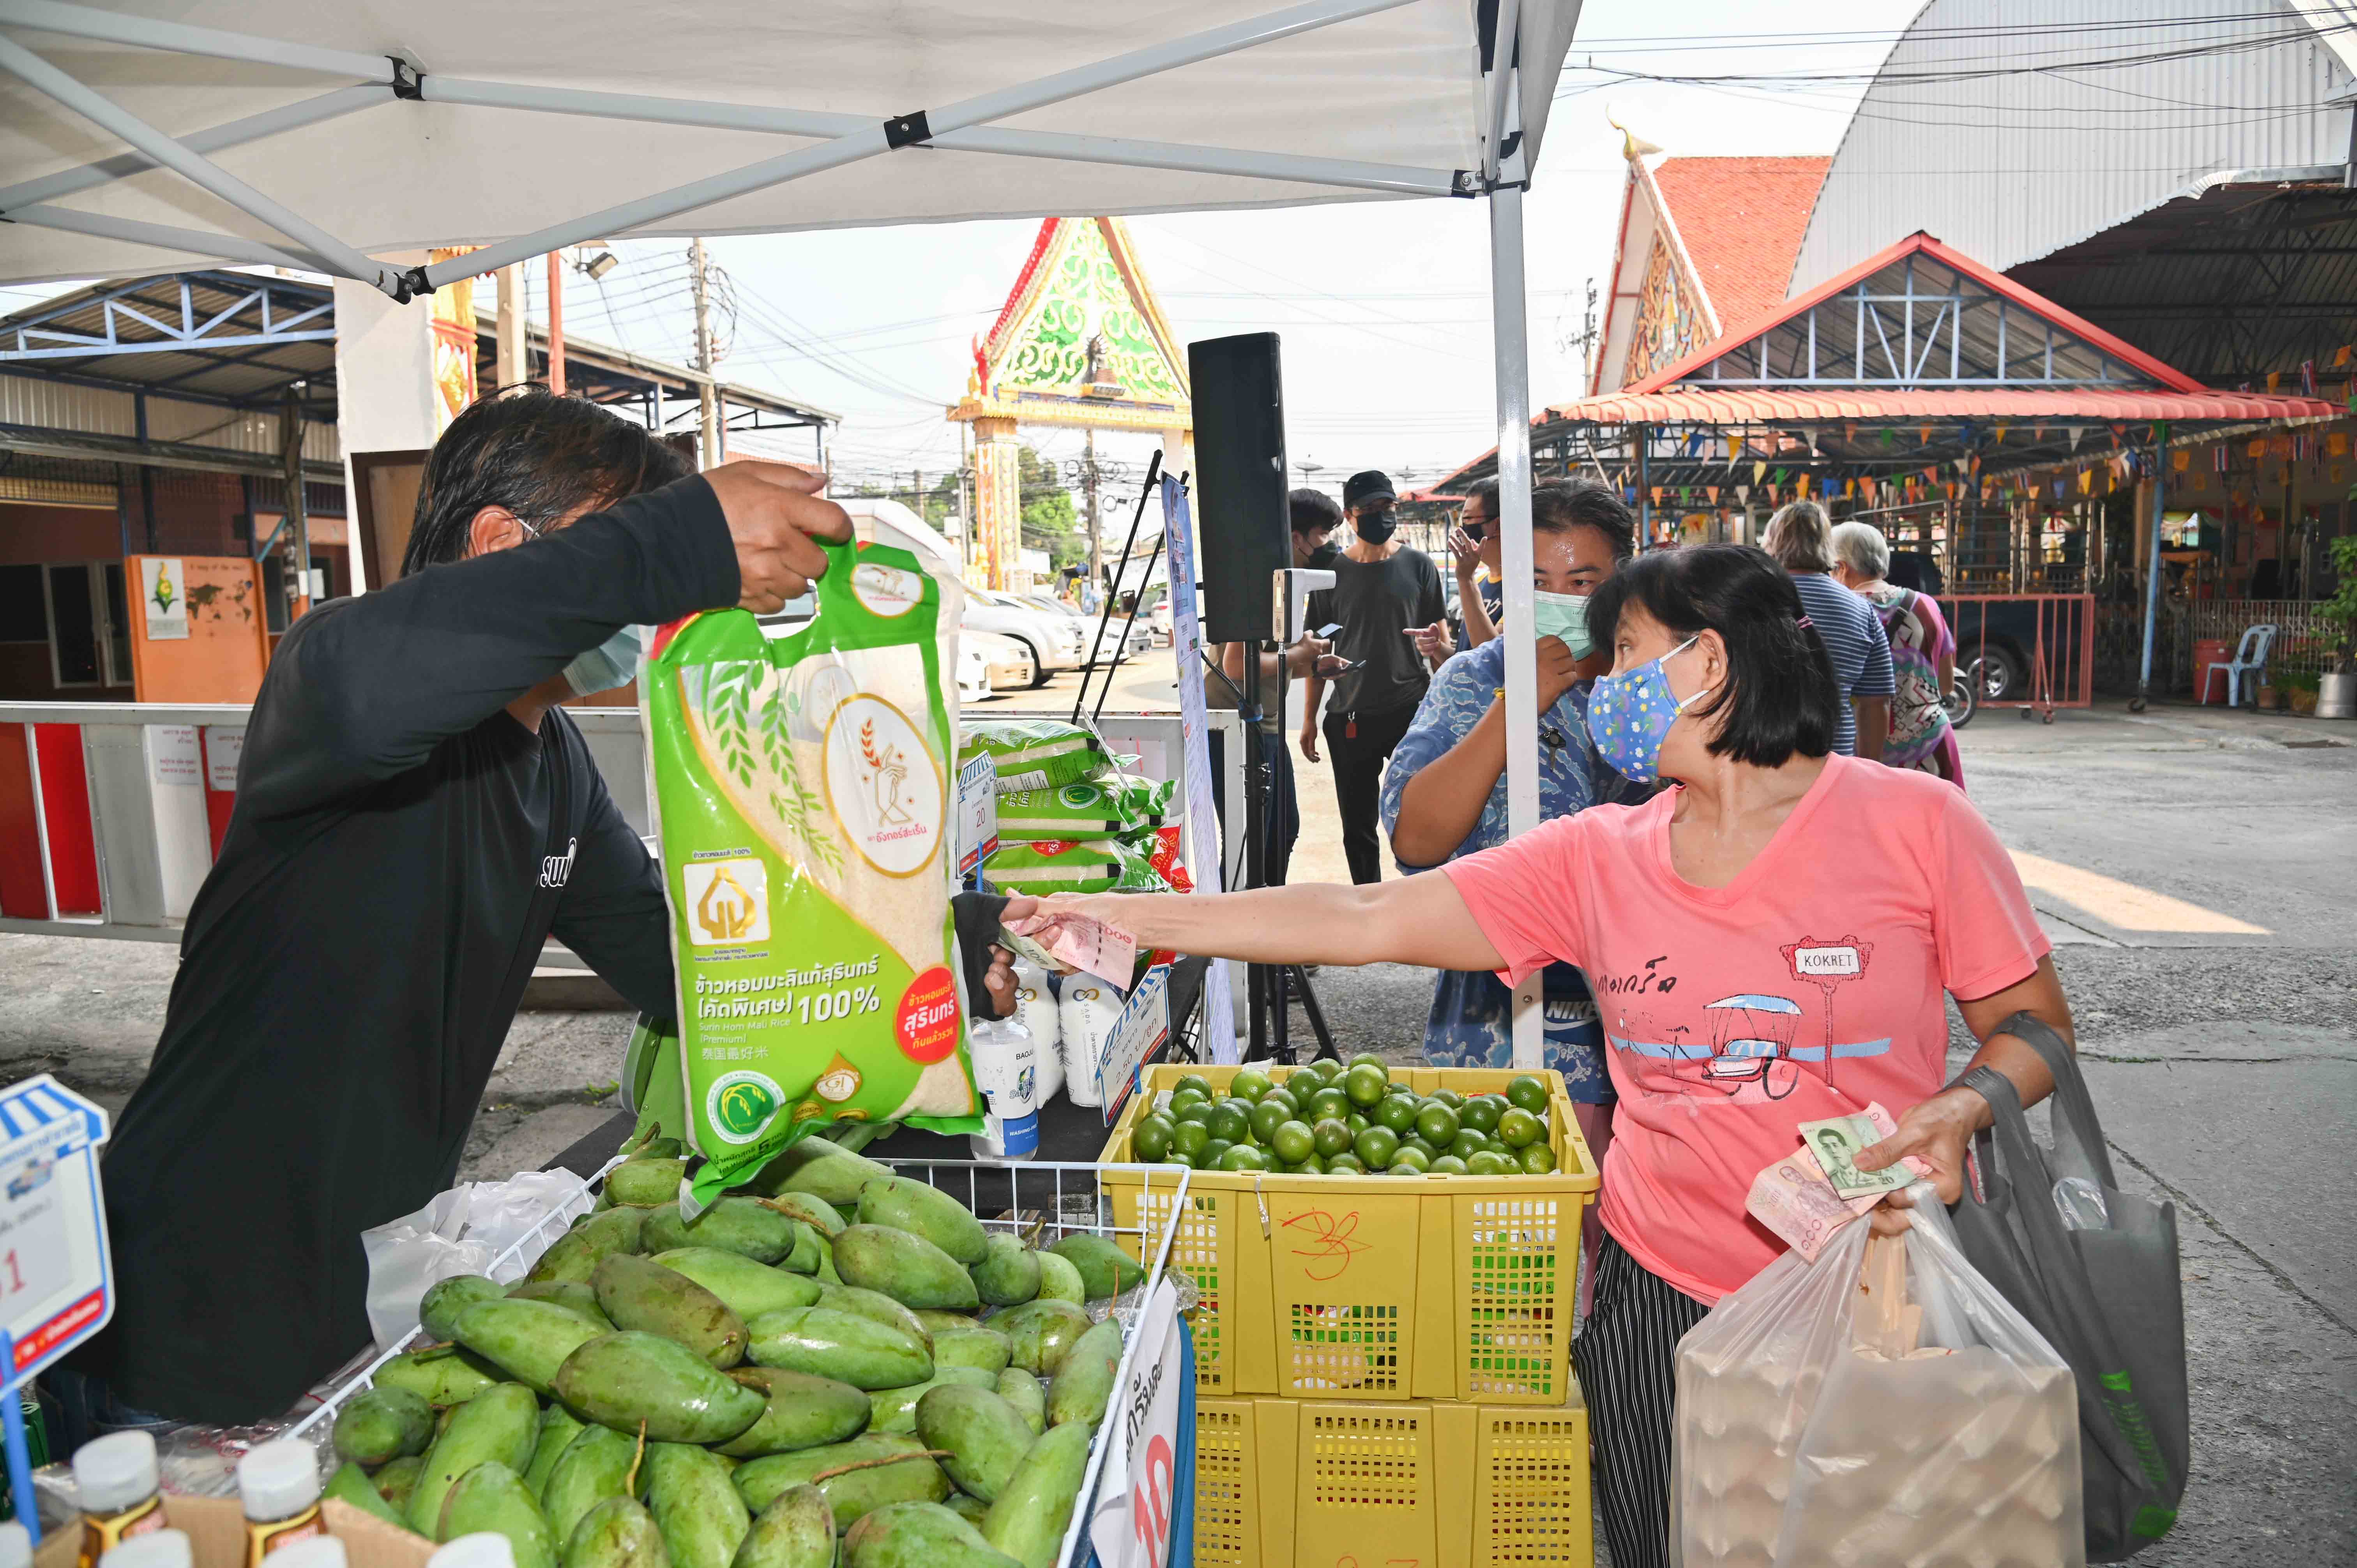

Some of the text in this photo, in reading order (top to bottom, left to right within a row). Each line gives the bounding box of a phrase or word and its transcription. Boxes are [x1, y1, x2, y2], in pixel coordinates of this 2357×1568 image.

[976, 807, 985, 828] 20
[1804, 955, 1852, 966] KOKRET
[695, 954, 880, 994] ข้าวหอมมะลิแท้สุรินทร์
[798, 984, 880, 1024] 100%
[904, 991, 954, 1038] สุรินทร์
[699, 1019, 791, 1031] Surin Hom Mali Rice
[702, 1045, 769, 1061] 泰国最好米
[1878, 1176, 1895, 1186] 20
